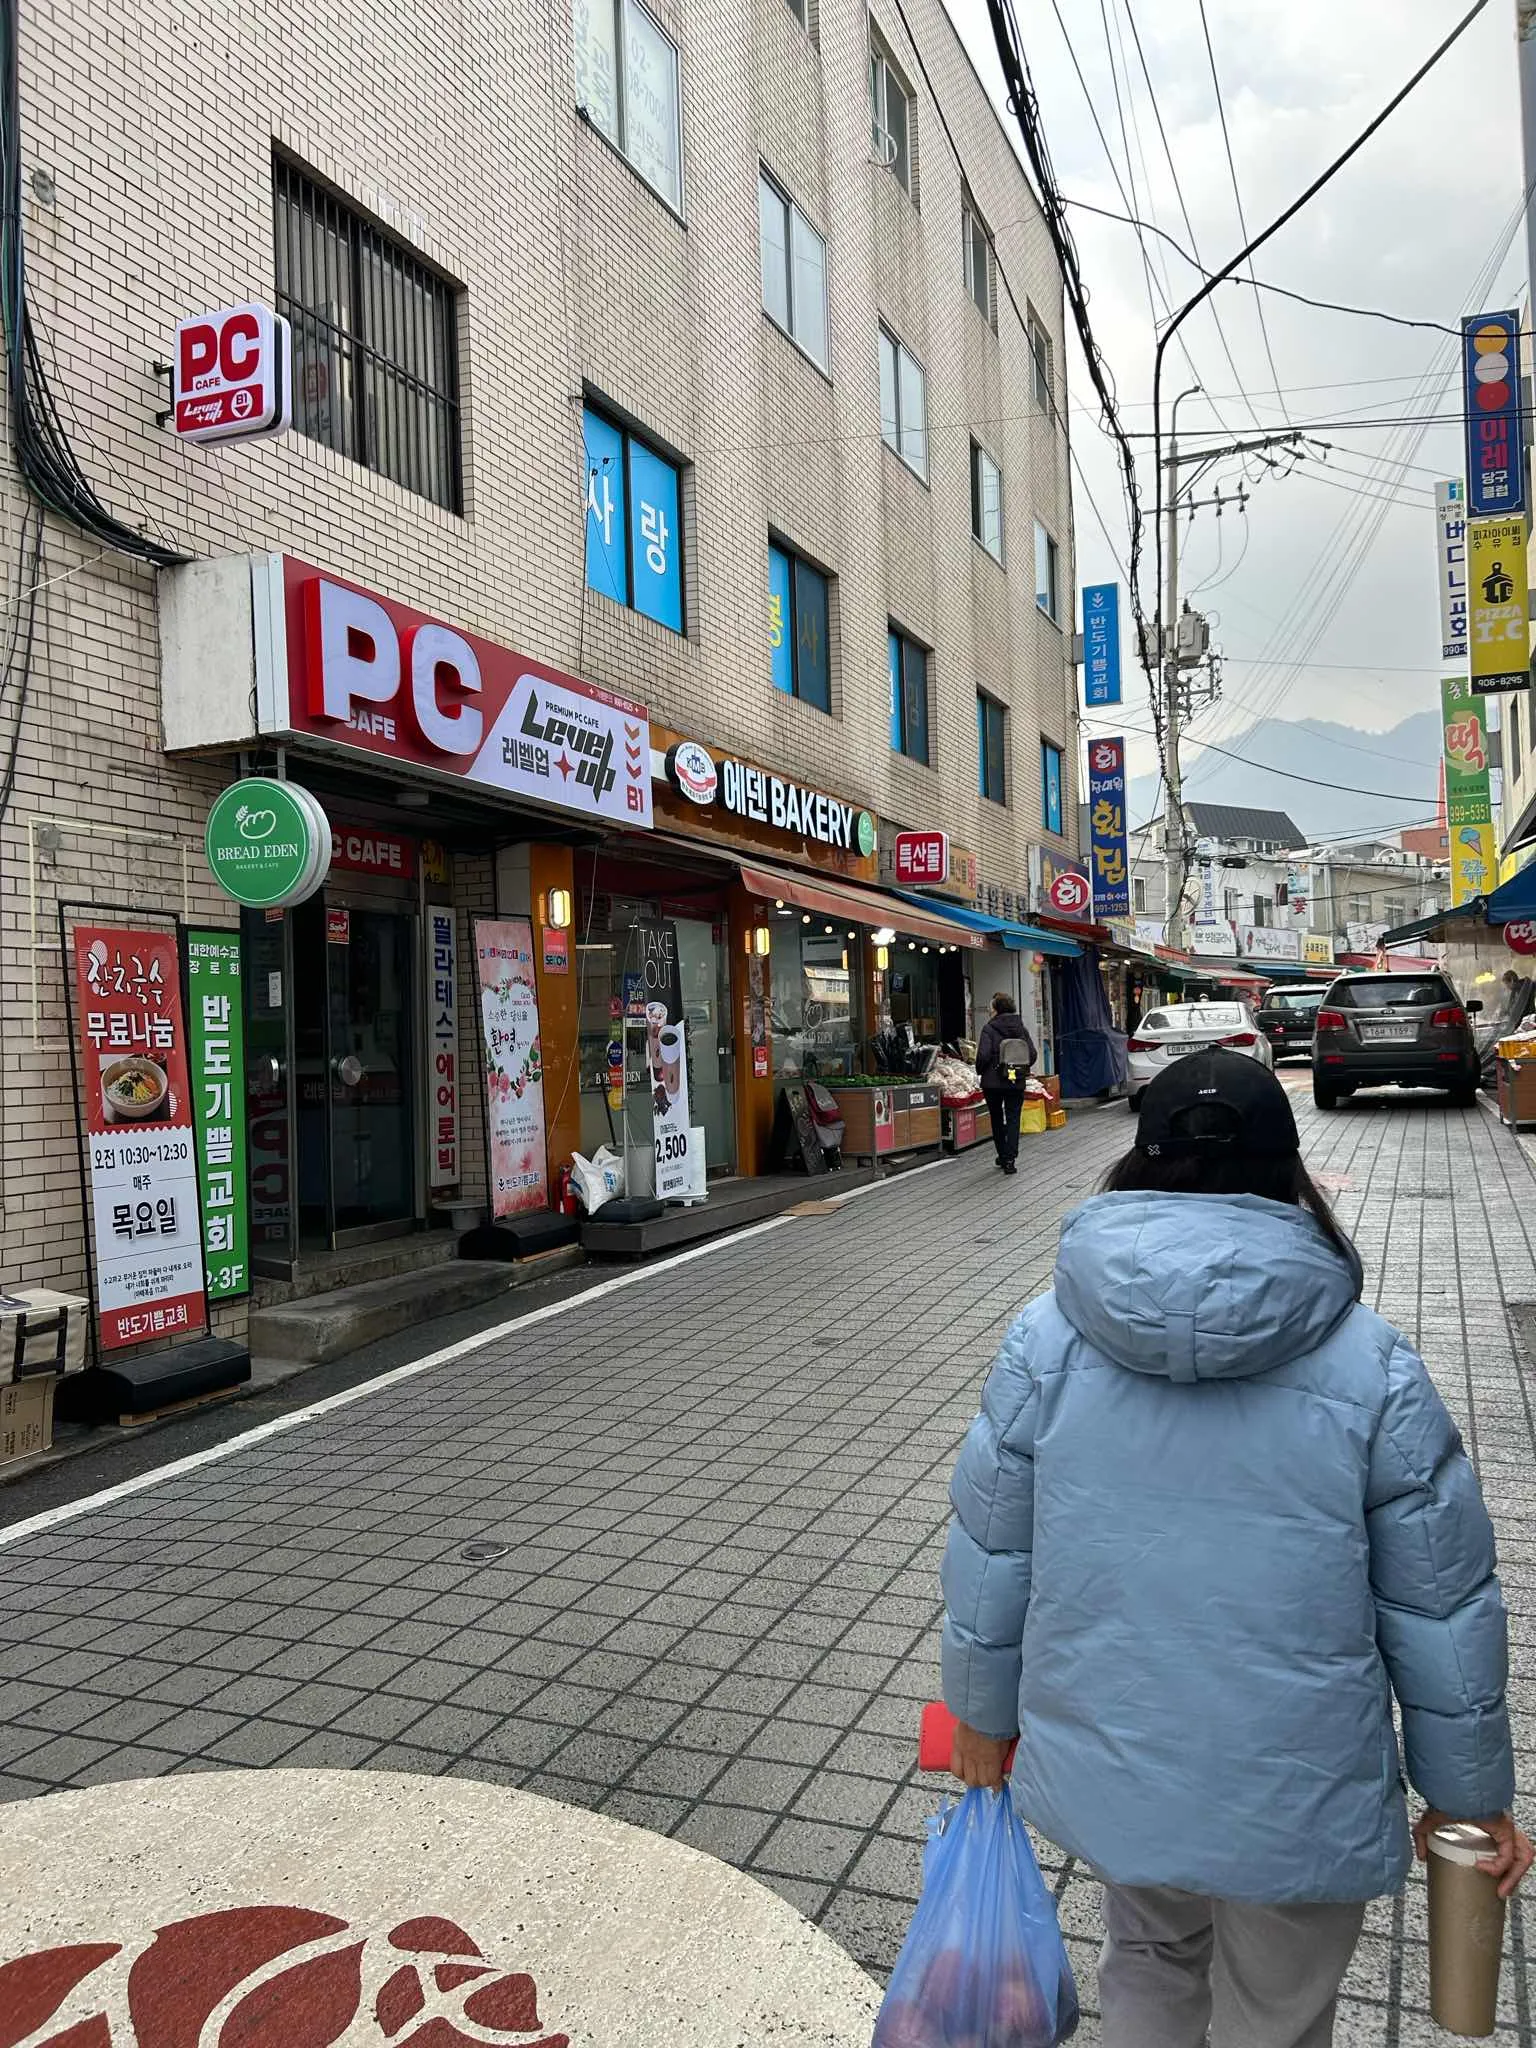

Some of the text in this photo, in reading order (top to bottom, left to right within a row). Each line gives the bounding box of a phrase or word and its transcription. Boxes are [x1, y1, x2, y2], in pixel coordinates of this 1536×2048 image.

[181, 314, 260, 394] PC
[195, 377, 221, 390] CAFE
[318, 577, 485, 756] PC
[1090, 615, 1108, 699] 반도기쁨교회
[1478, 677, 1523, 688] 906-8295
[344, 708, 397, 741] CAFE
[545, 700, 599, 728] PREMIUM PC CAFE
[502, 736, 550, 778] 레벨업
[1095, 745, 1117, 768] 회
[1447, 717, 1485, 770] 떡
[627, 784, 644, 813] B1
[723, 759, 853, 849] 에덴 BAKERY
[217, 843, 298, 861] BREAD EDEN
[346, 835, 402, 868] CAFE
[899, 841, 940, 873] 특산물
[1092, 798, 1126, 886] 횟집
[1057, 878, 1081, 905] 회
[189, 943, 240, 960] 대한예수교
[640, 930, 674, 960] TAKE
[645, 960, 673, 989] OUT
[87, 1012, 174, 1049] 무료나눔
[202, 994, 235, 1253] 반도기쁨교회
[94, 1142, 188, 1170] 오전 10:30~12:30
[655, 1134, 688, 1164] 2,500
[133, 1174, 152, 1191] 매주
[112, 1196, 177, 1240] 목요일
[117, 1304, 188, 1340] 반도기쁨교회
